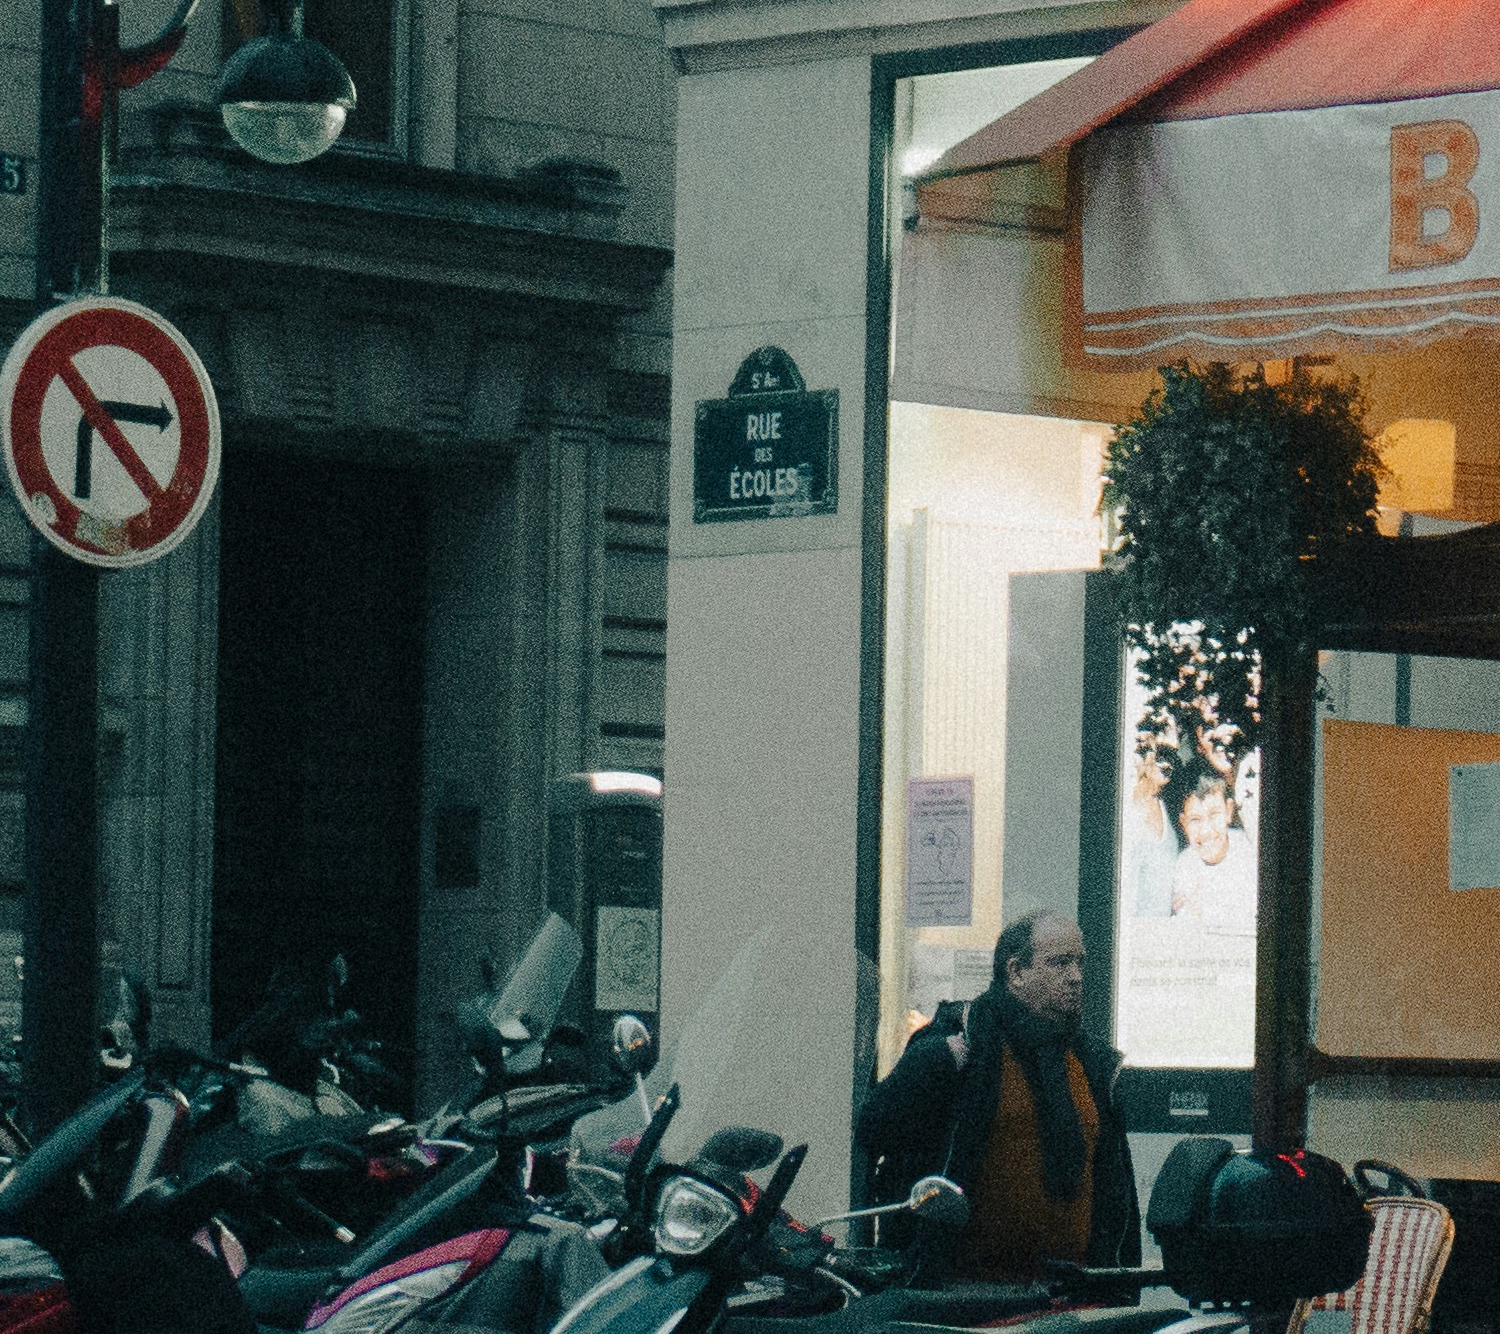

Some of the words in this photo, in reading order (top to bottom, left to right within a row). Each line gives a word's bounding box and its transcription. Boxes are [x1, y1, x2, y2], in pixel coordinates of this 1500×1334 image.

[747, 412, 782, 440] RUE
[754, 447, 773, 463] DES
[730, 465, 799, 499] ÉCOLES
